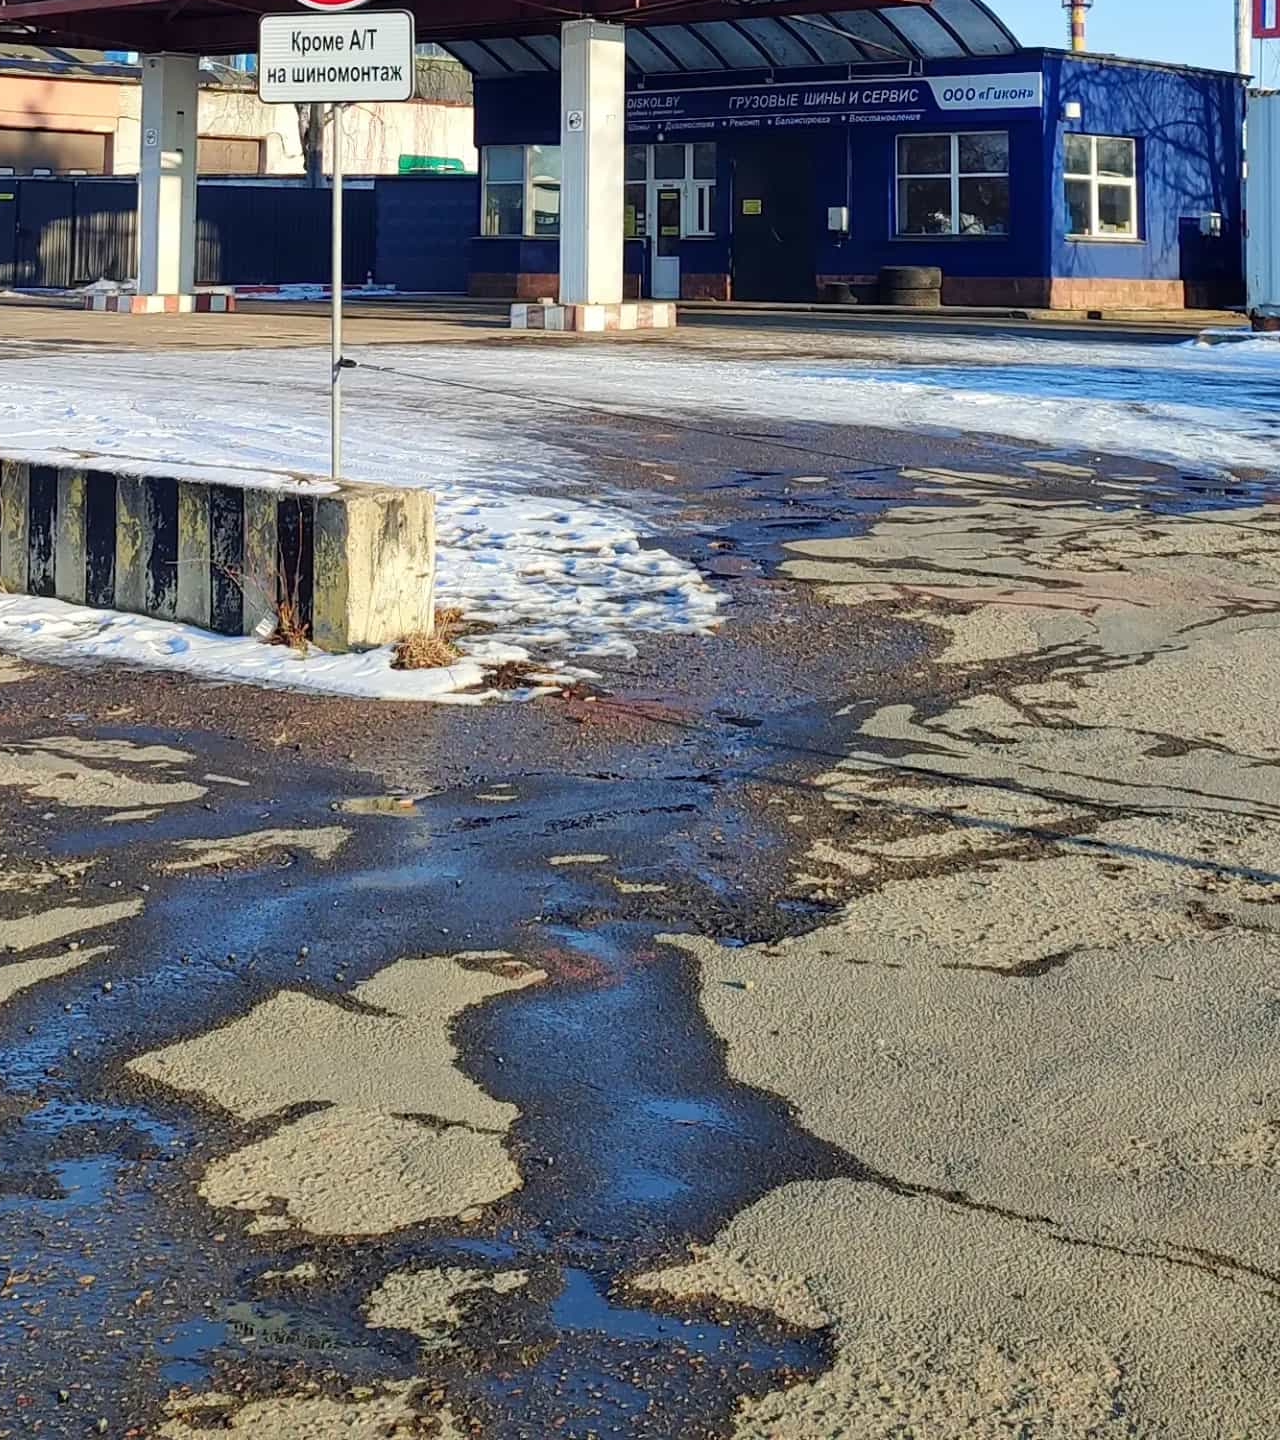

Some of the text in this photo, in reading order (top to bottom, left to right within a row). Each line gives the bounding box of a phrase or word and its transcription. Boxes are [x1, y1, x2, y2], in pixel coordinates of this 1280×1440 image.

[291, 31, 344, 56] Кроме
[267, 65, 402, 83] на шиномонтаж
[728, 88, 920, 109] ГРУЗОВЫЕ ШИНЫ И СЕРВИС
[943, 87, 976, 102] ООО
